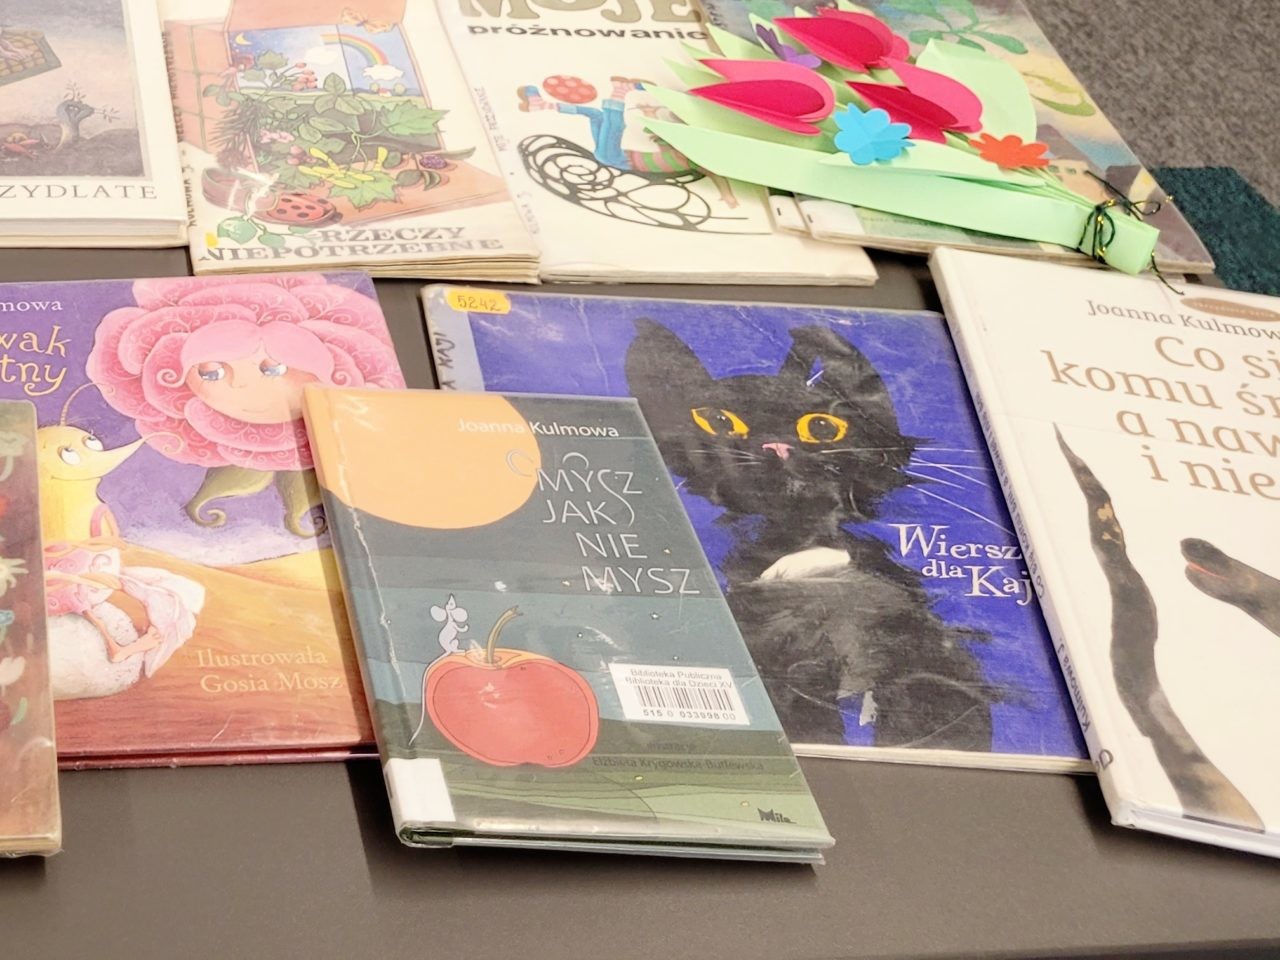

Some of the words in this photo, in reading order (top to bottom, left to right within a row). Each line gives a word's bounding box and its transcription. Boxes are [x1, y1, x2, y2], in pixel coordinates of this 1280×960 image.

[320, 226, 465, 243] RZECZY
[198, 239, 504, 261] NIEPOTRZEBNE
[457, 295, 501, 311] 5242
[1086, 300, 1174, 325] Joanna
[1178, 314, 1280, 340] Kulmow
[1154, 335, 1225, 373] Co
[1040, 349, 1223, 410] komu
[458, 418, 525, 434] Joanna
[529, 421, 619, 437] Kulmowa
[1116, 409, 1156, 439] a
[1165, 417, 1280, 458] naw
[1141, 444, 1169, 482] i
[537, 468, 642, 513] MYSZ
[542, 499, 617, 525] JAK
[575, 532, 648, 558] NIE
[887, 523, 1022, 560] Wiersz
[581, 566, 700, 594] MYSZ
[922, 558, 966, 579] dla
[964, 565, 1033, 606] Kaj
[195, 645, 328, 668] Ilustrowała
[200, 673, 269, 693] Gosia
[278, 671, 345, 691] Mosz
[625, 676, 672, 686] Biblioteka
[672, 678, 687, 687] dla
[630, 668, 677, 679] Biblioteka
[677, 670, 722, 680] Publiczna
[1061, 658, 1092, 731] Kulmowa
